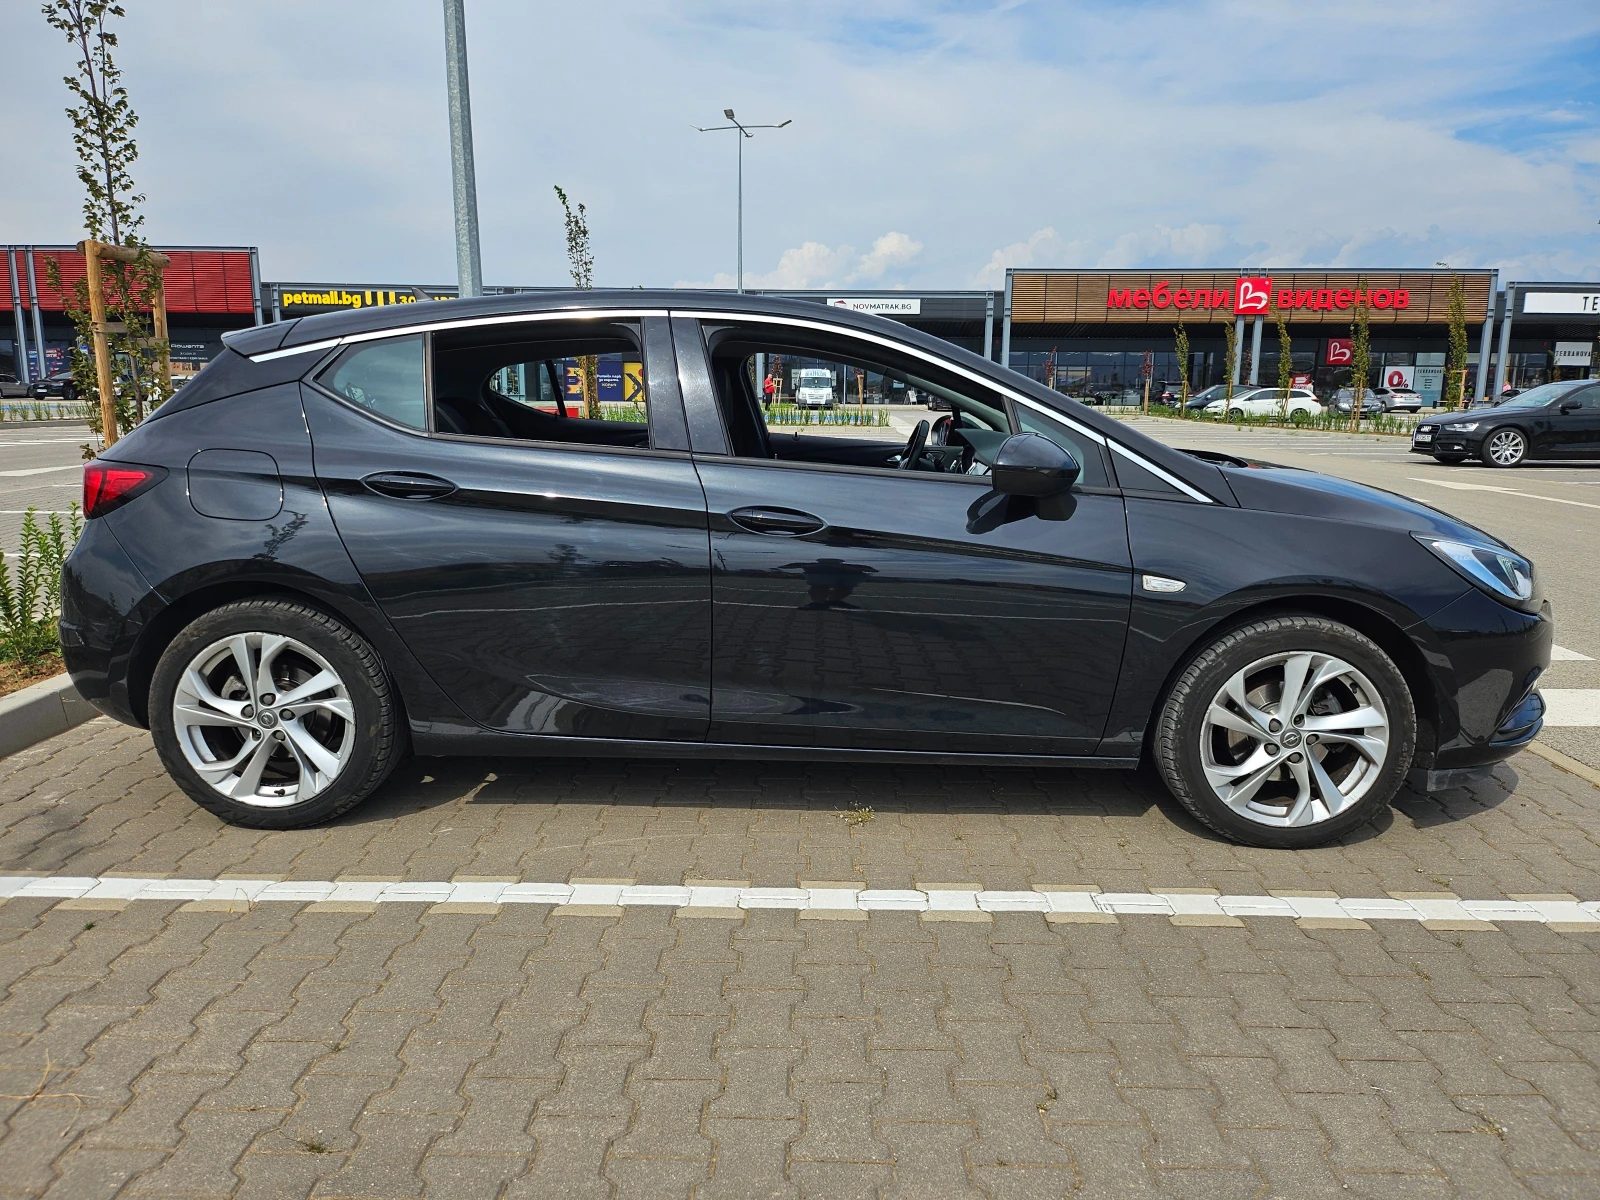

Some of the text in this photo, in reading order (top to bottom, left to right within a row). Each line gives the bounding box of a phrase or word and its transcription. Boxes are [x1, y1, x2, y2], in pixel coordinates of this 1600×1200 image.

[283, 290, 362, 309] petmall.bg
[1107, 280, 1229, 309] мебели
[1277, 288, 1410, 311] виденов
[853, 303, 912, 311] NOVMATRAK.BG
